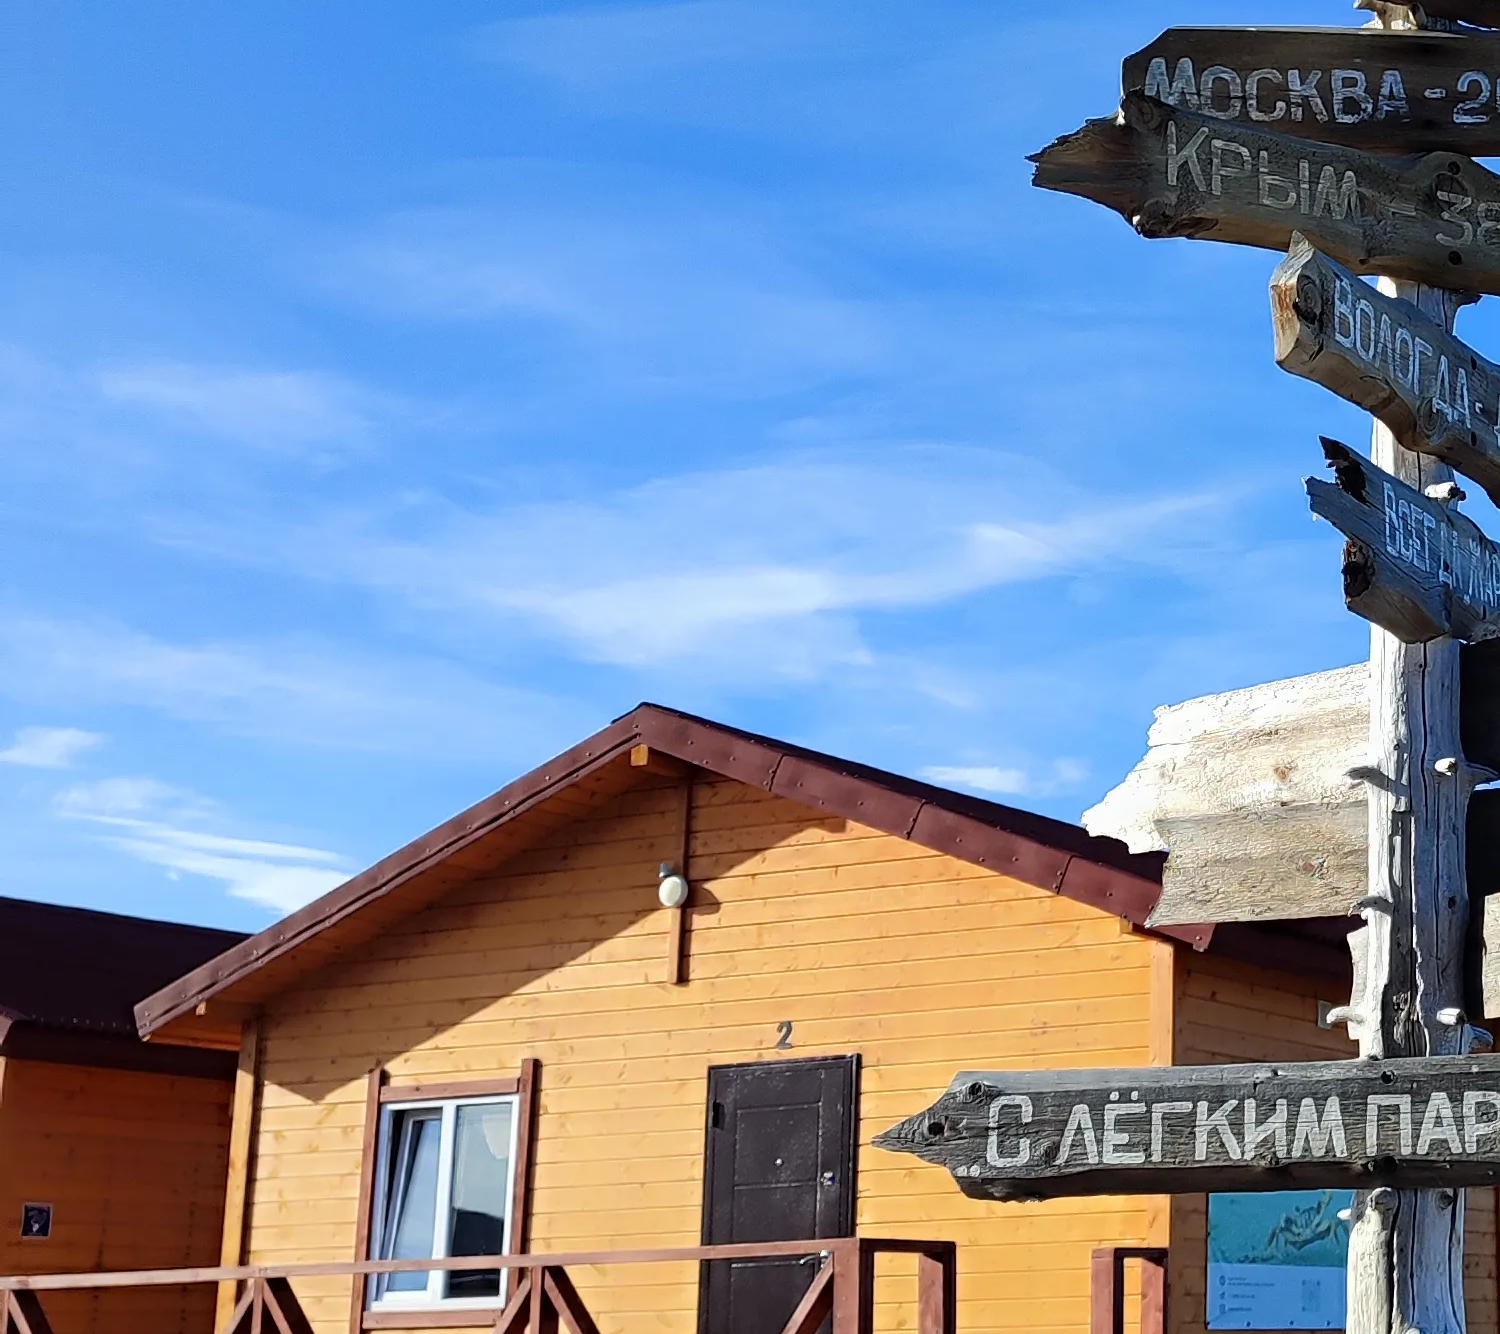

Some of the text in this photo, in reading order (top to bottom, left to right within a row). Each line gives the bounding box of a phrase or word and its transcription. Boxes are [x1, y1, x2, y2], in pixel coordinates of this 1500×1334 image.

[1144, 57, 1410, 124] МОСКВА
[1166, 120, 1362, 221] КРЫМ
[1334, 277, 1471, 429] ВОЛОГДА
[776, 1020, 793, 1050] 2
[1055, 1090, 1349, 1165] ЛЁГКИМ
